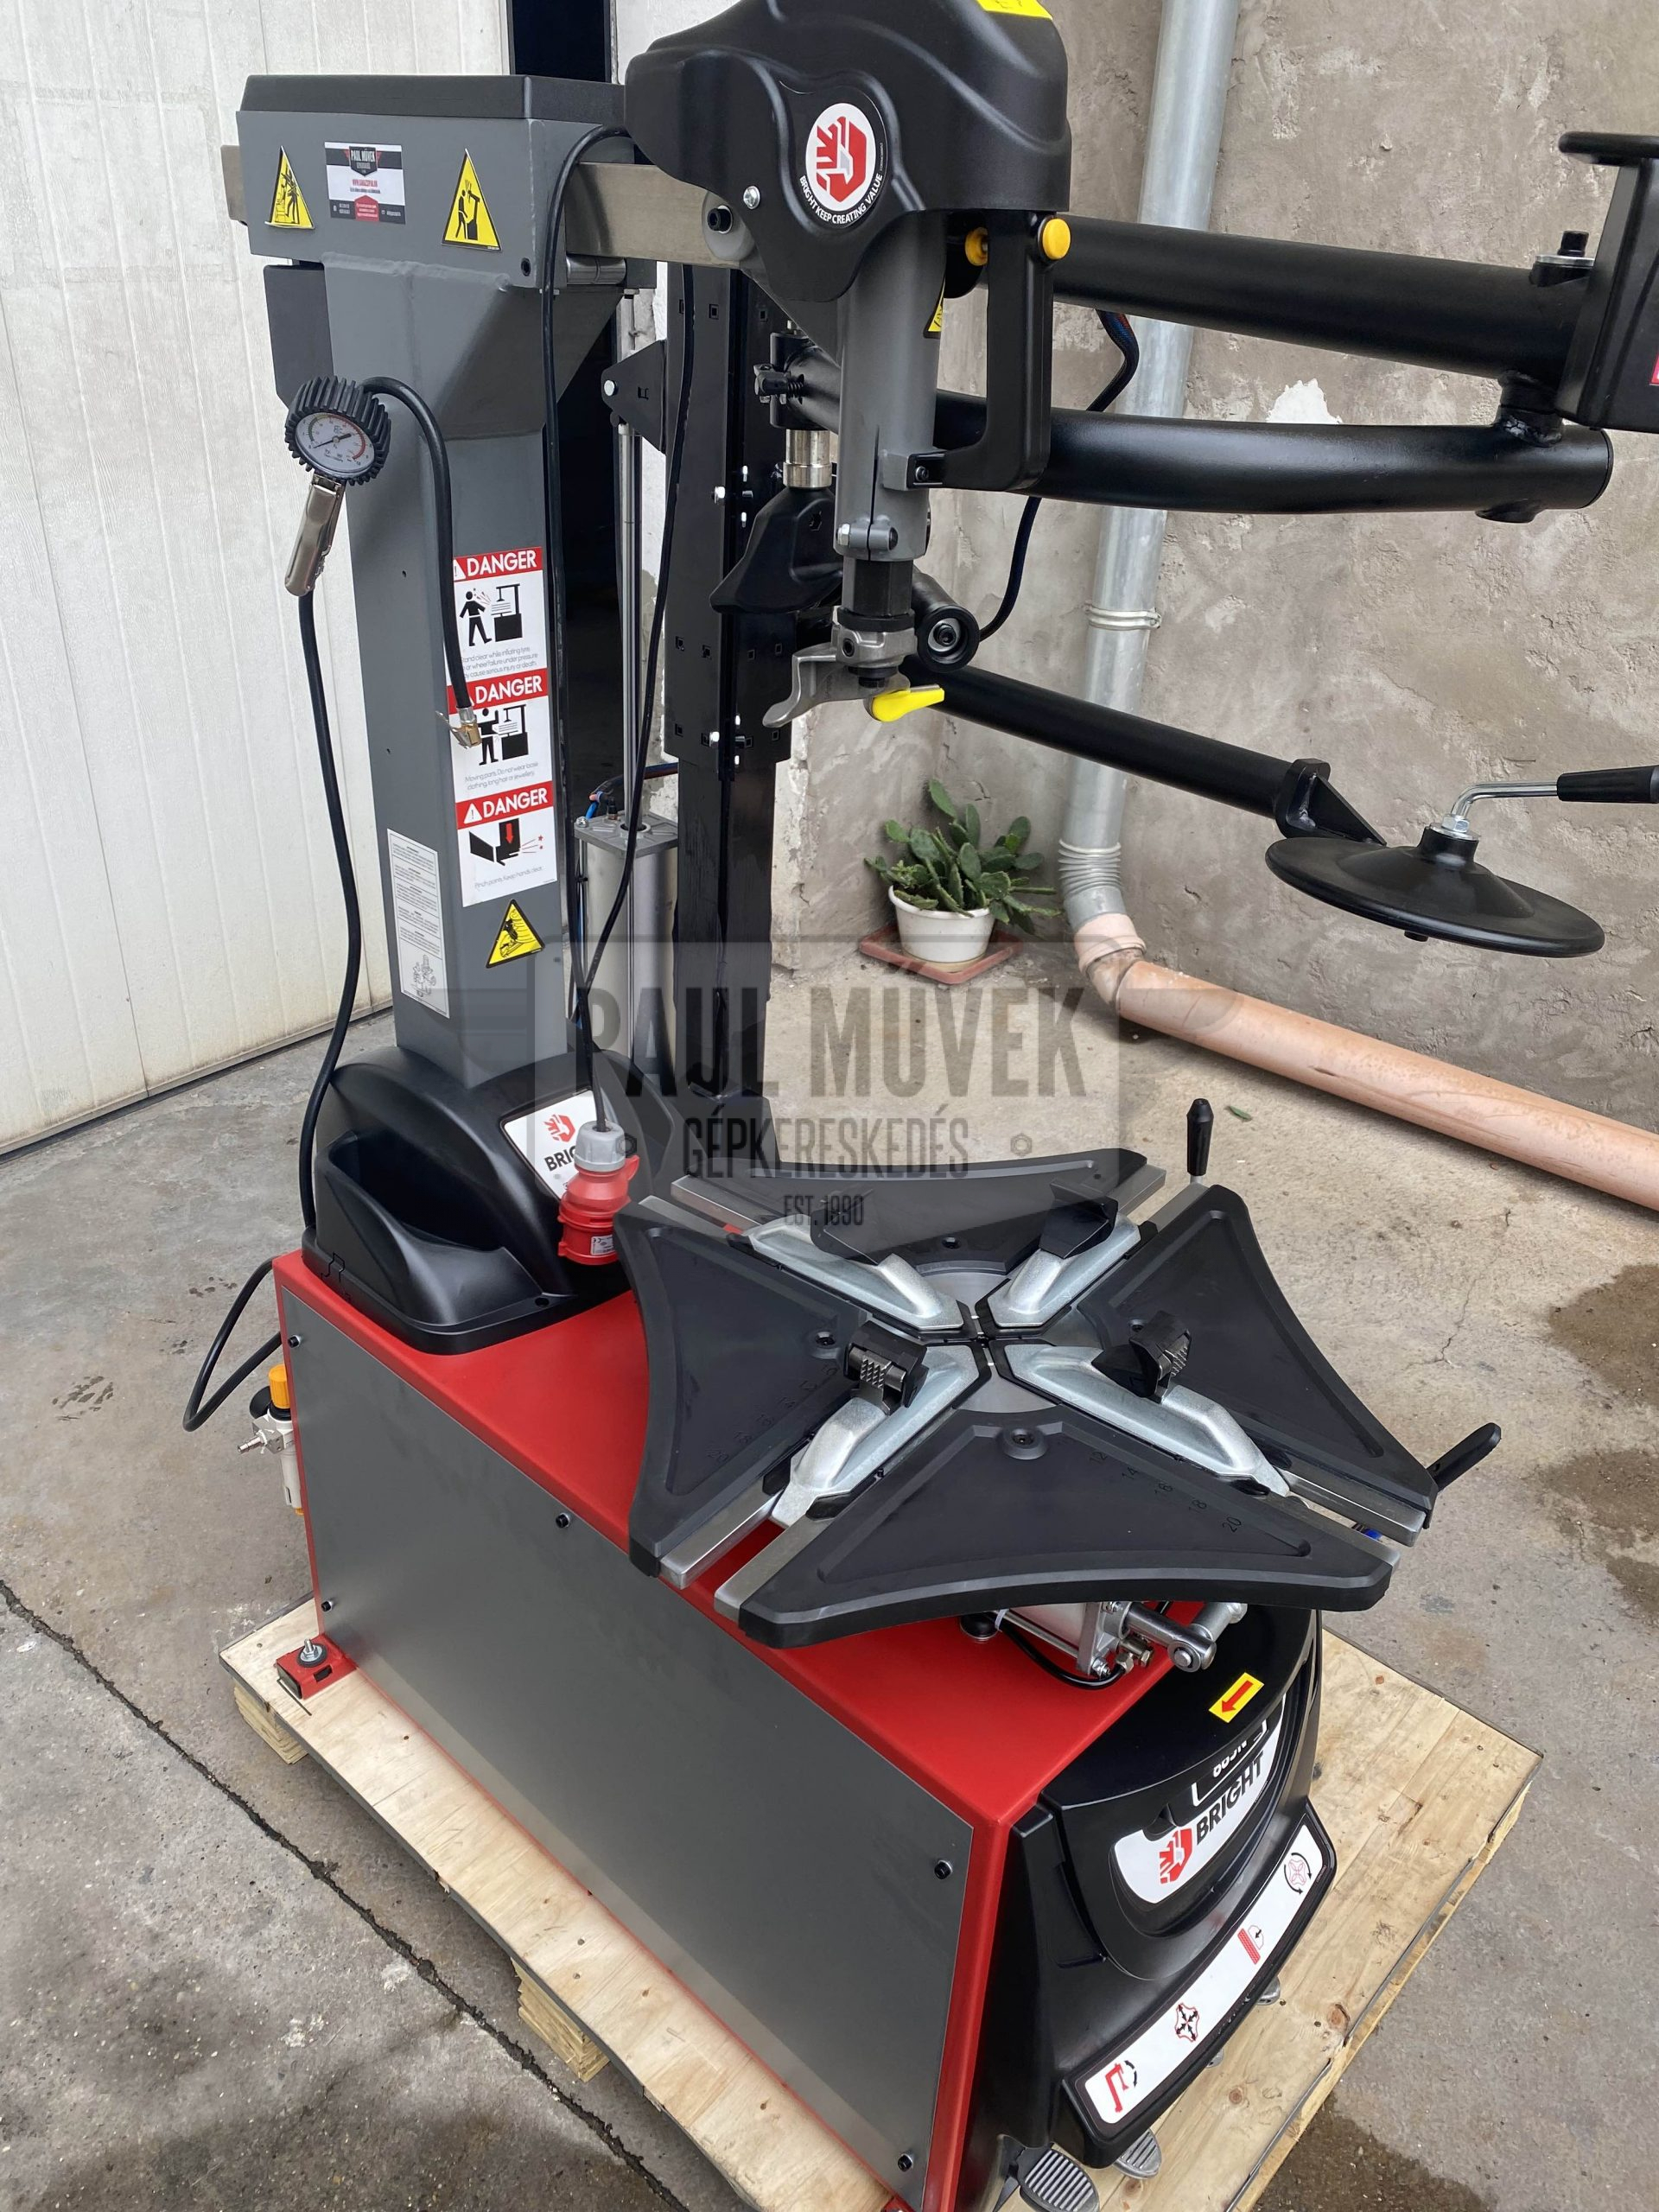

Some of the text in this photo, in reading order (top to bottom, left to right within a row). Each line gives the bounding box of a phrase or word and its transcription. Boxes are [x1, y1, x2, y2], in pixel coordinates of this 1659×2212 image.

[799, 173, 882, 224] BRIGHT KEEP CREATING VALUE
[467, 550, 537, 576] DANGER
[474, 675, 543, 704] DANGER
[482, 787, 548, 817] DANGER
[1222, 1515, 1243, 1533] 20
[1197, 1751, 1263, 1846] BRIGHT
